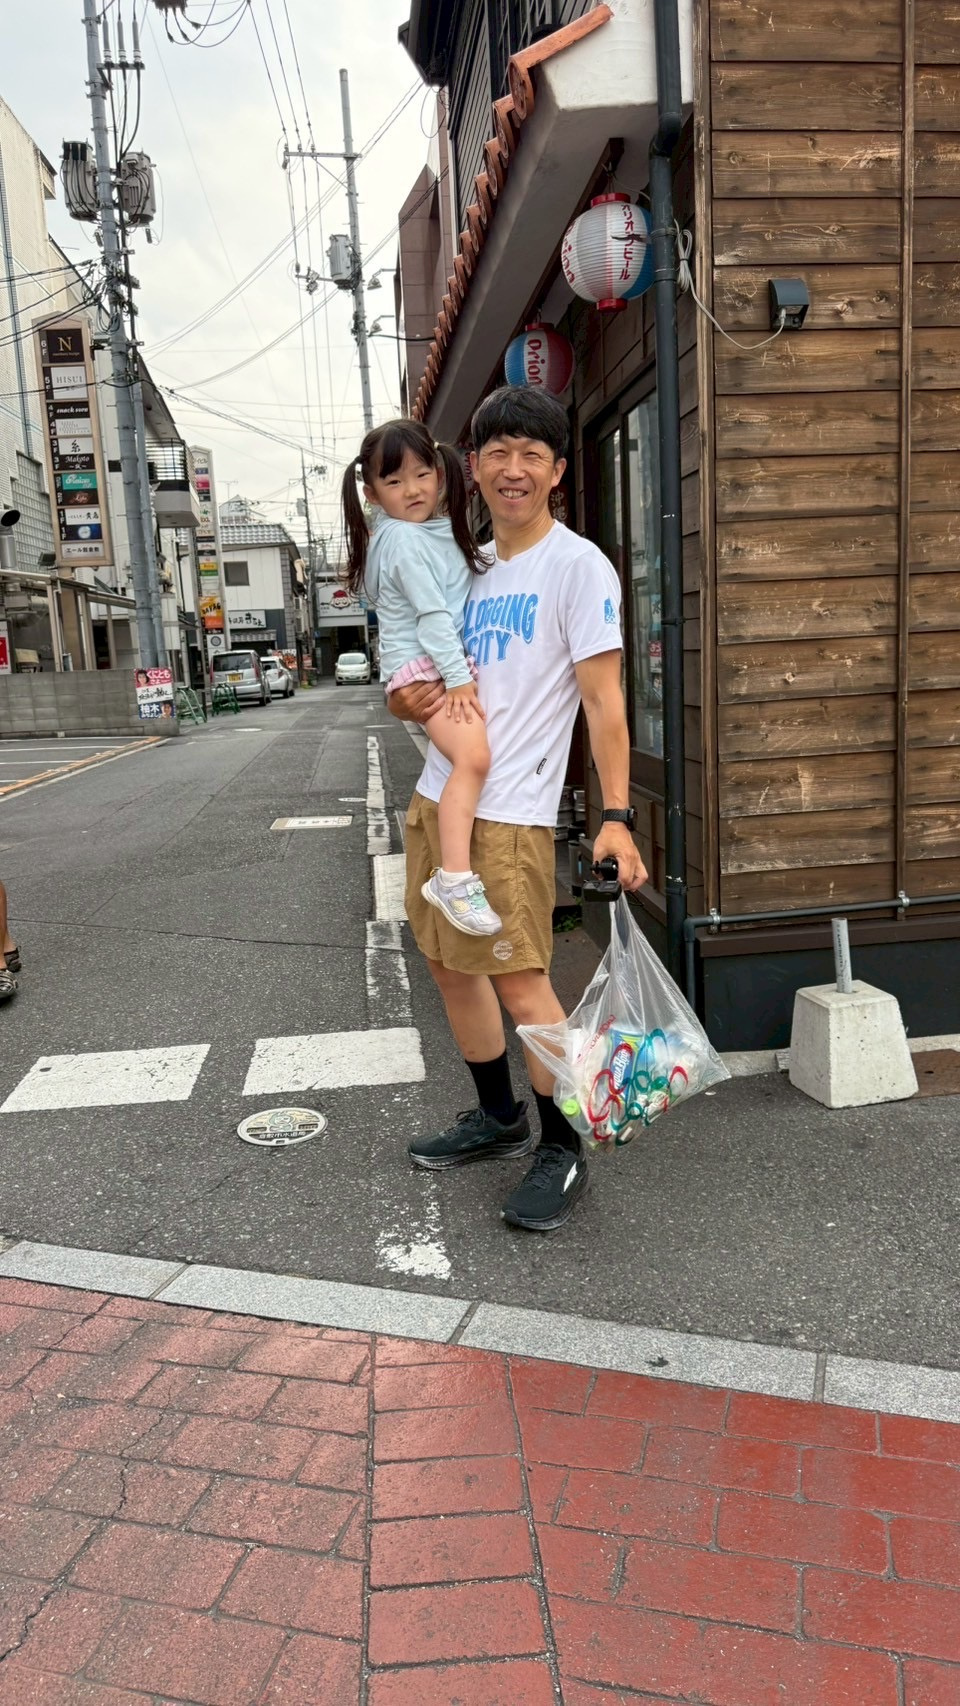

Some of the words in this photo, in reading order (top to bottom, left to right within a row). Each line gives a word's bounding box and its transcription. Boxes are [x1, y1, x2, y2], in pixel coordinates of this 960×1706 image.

[619, 204, 635, 280] オリオンビール
[58, 337, 72, 351] N
[527, 339, 544, 385] Orion
[56, 376, 83, 384] HISUI
[464, 593, 539, 645] LOGGING
[468, 630, 512, 666] CITY
[147, 670, 171, 679] くにとも
